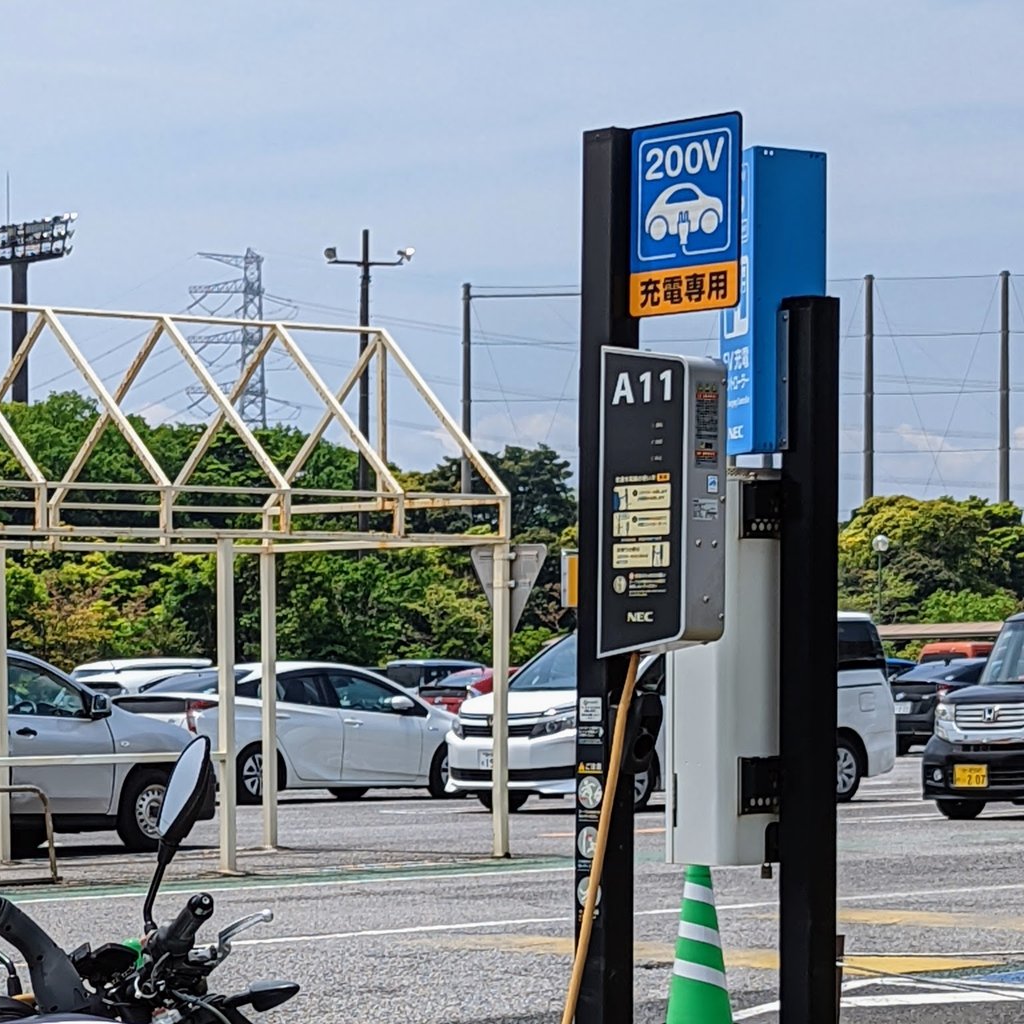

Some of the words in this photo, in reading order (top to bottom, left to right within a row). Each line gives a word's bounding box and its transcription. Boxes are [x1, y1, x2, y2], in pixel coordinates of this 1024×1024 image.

[645, 136, 725, 181] 200V
[640, 270, 728, 308] 充電専用
[612, 369, 672, 405] A11
[627, 611, 654, 622] NEC
